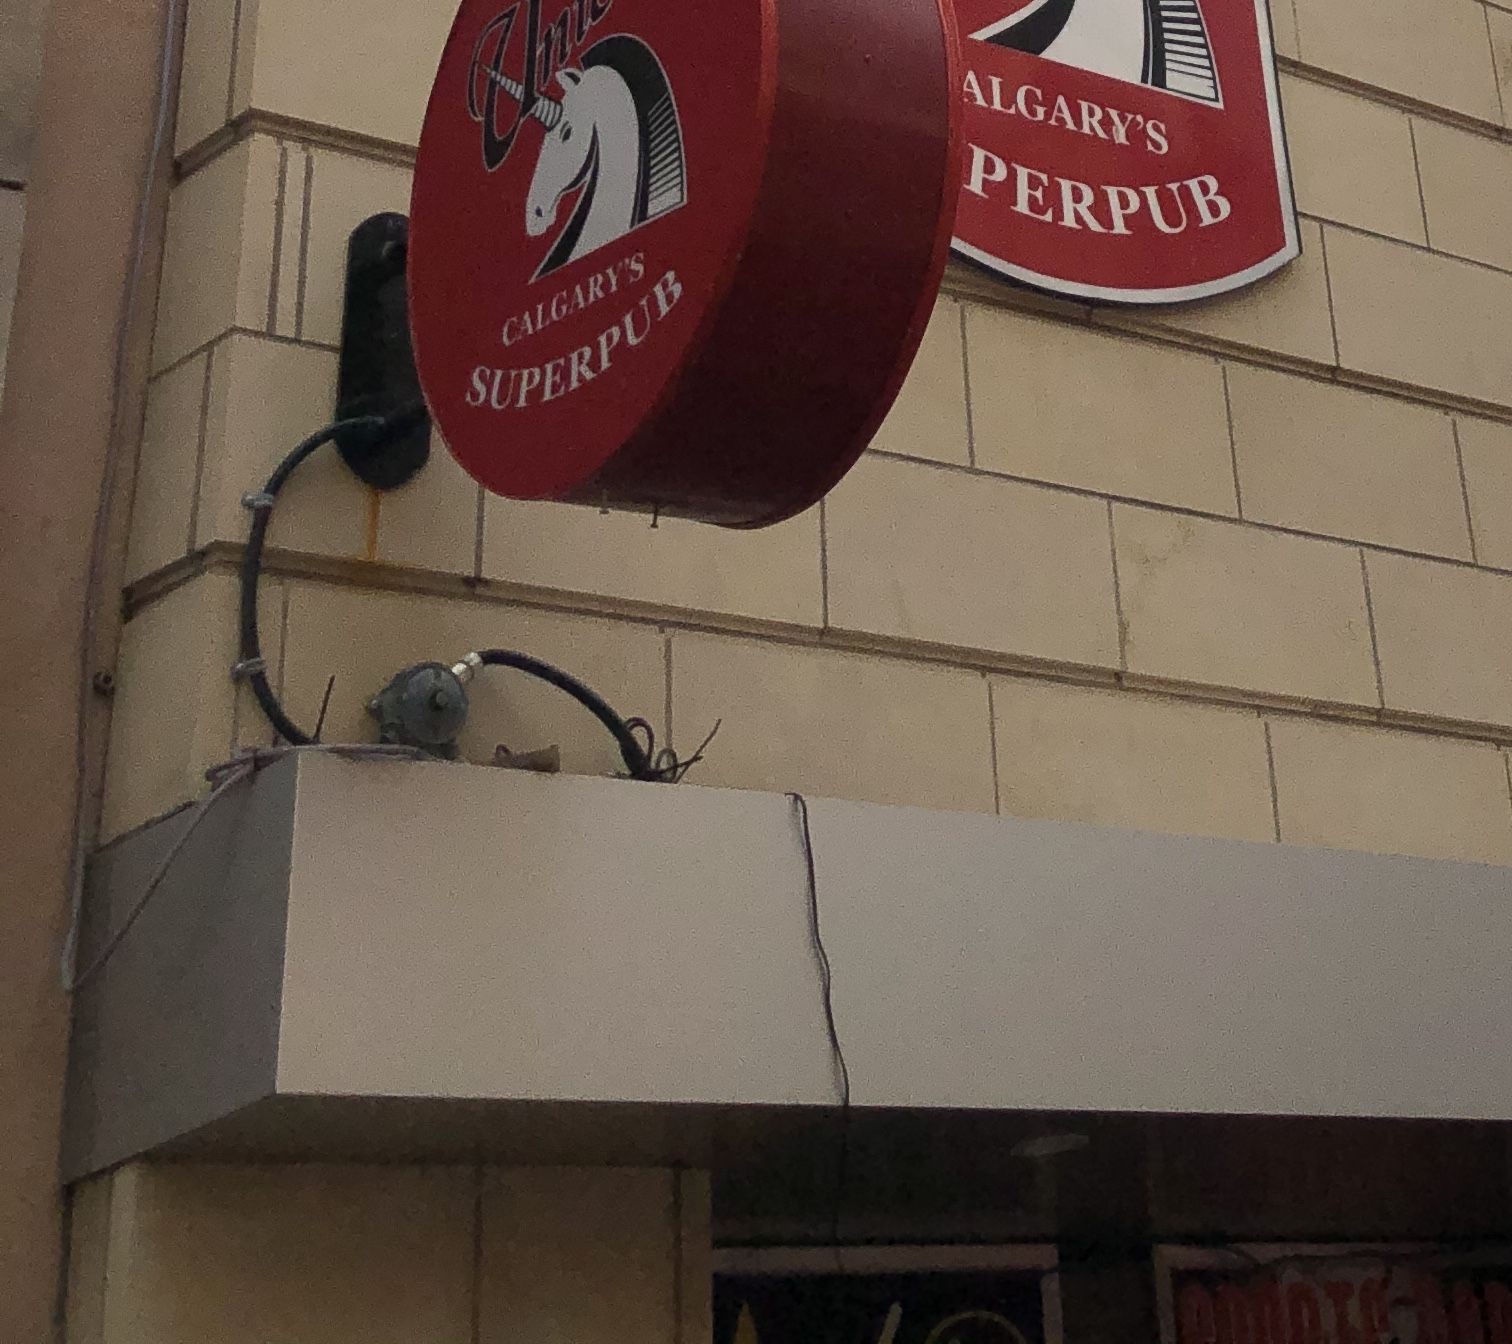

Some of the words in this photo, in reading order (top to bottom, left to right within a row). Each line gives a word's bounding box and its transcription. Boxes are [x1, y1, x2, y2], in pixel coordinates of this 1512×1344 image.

[962, 69, 1169, 155] ALGARY'S
[962, 142, 1231, 235] PERPUB
[465, 269, 683, 410] SUPERPUB
[501, 252, 645, 347] CALGARY'S
